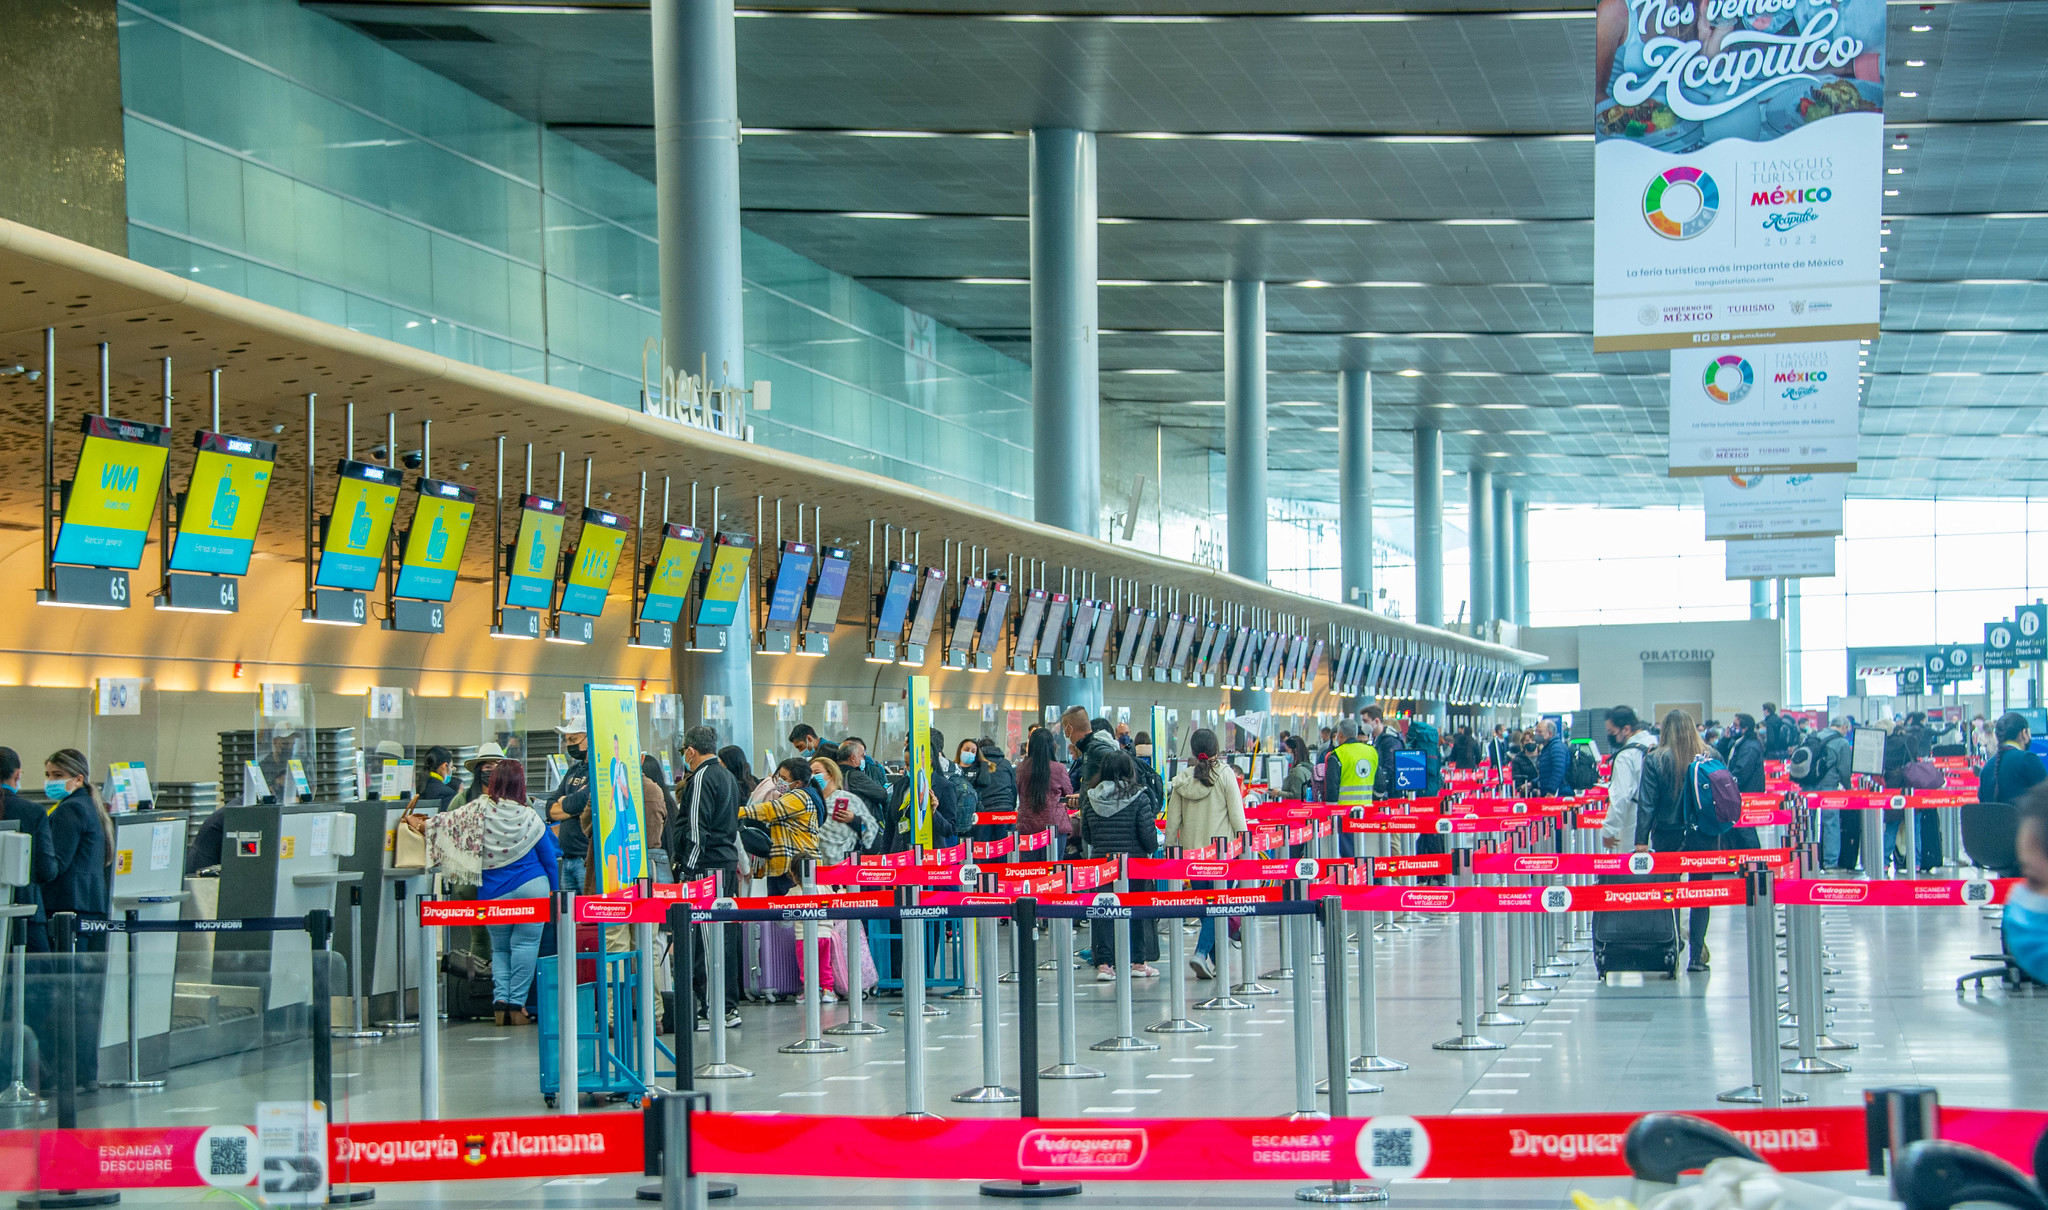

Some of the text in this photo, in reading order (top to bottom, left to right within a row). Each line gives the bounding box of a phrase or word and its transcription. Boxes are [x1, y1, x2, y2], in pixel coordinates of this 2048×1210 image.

[1613, 8, 1863, 121] Acapulco
[1752, 157, 1832, 172] TIANGUIS
[1762, 207, 1819, 232] Acapulco
[1627, 269, 1638, 278] La
[1640, 267, 1662, 277] feria
[1733, 261, 1790, 273] importante
[1792, 260, 1806, 269] de
[1727, 304, 1775, 313] TURISMO
[1663, 311, 1713, 322] MÉXICO
[643, 336, 744, 440] Check in
[119, 425, 145, 438] SAMSUNG
[228, 440, 253, 453] SAMSUNG
[111, 577, 126, 600] 65
[220, 584, 235, 605] 64
[353, 598, 364, 619] 63
[431, 609, 442, 628] 62
[529, 615, 538, 633] 61
[584, 622, 592, 639] 60
[663, 628, 671, 643] 59
[719, 631, 726, 647] 58
[783, 635, 790, 650] 57
[1640, 649, 1715, 661] ORATORIO
[1398, 859, 1439, 869] Alemana
[1680, 855, 1727, 866] Droguería
[1005, 867, 1046, 878] Droguería
[1218, 894, 1266, 904] Alemana
[1604, 887, 1729, 902] Droguería Alemana
[423, 906, 535, 919] Droguería Alemana
[782, 908, 828, 917] BIOMIG
[900, 906, 948, 916] MIGRACIÓN
[1086, 907, 1132, 916] BIOMIG
[1206, 904, 1255, 914] MIGRACIÓN
[1252, 1134, 1333, 1147] ESCANEA Y
[1509, 1129, 1623, 1161] Droguer
[100, 1145, 174, 1157] ESCANEA Y
[335, 1130, 605, 1166] Droguería Alemana
[1050, 1151, 1129, 1165] virtual.com
[1253, 1149, 1331, 1162] DESCUBRE
[101, 1160, 172, 1172] DESCUBRE
